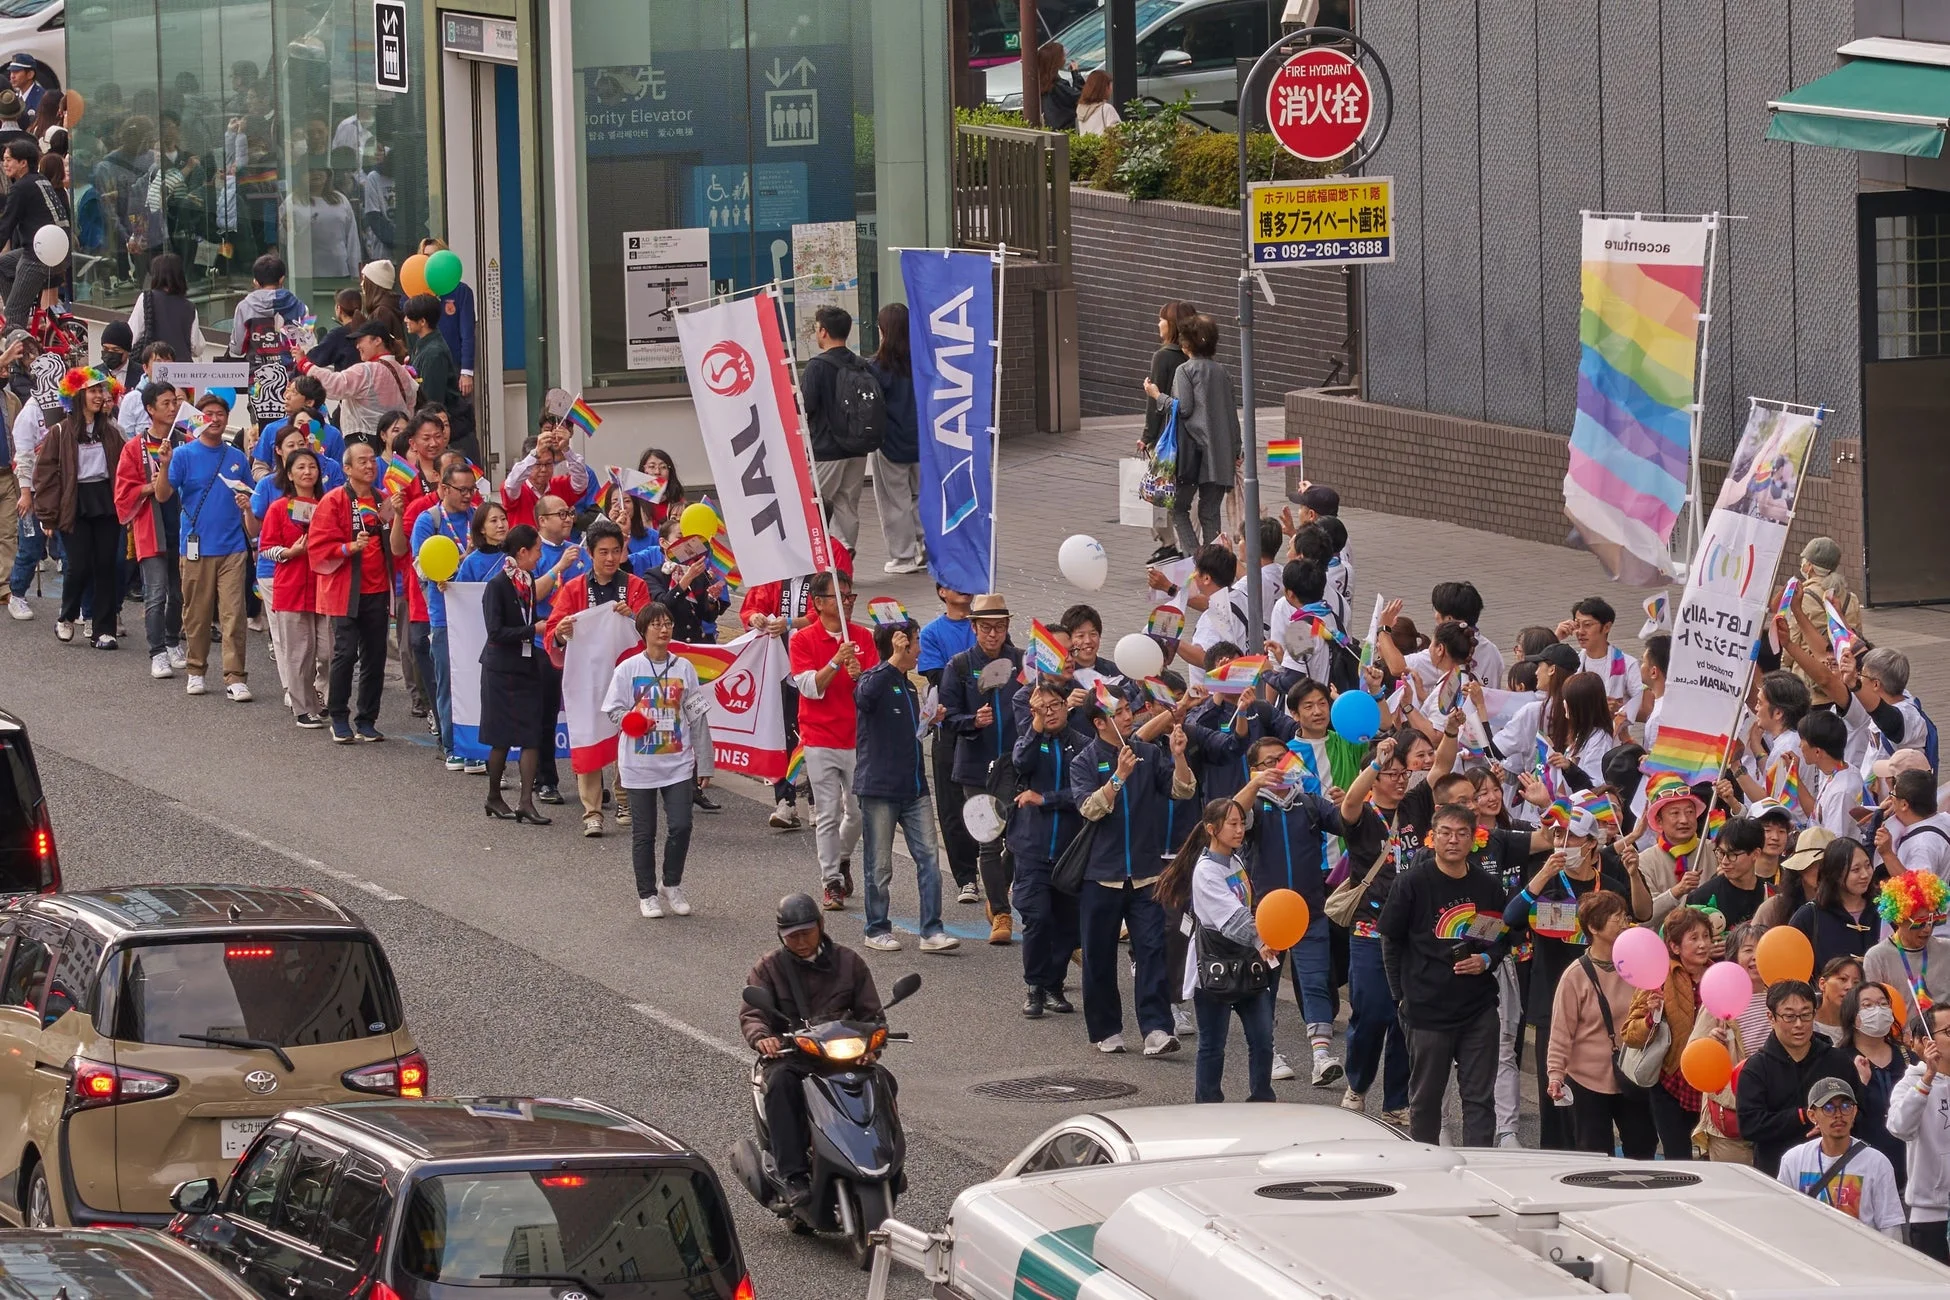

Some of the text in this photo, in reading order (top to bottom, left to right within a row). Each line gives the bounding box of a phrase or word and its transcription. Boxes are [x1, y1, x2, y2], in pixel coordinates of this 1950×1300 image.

[1285, 63, 1352, 77] FIRE HYDRANT
[594, 65, 666, 103] 先
[631, 109, 693, 123] Elevator
[1278, 82, 1362, 126] 消火栓
[1259, 205, 1387, 238] 博多プライベート歯科
[631, 238, 638, 248] 2
[1281, 240, 1383, 259] 092-260-3688
[738, 352, 752, 382] JAL
[730, 403, 787, 542] JAL
[811, 527, 825, 565] 日本航空
[725, 698, 749, 710] JAL
[554, 731, 568, 750] Q
